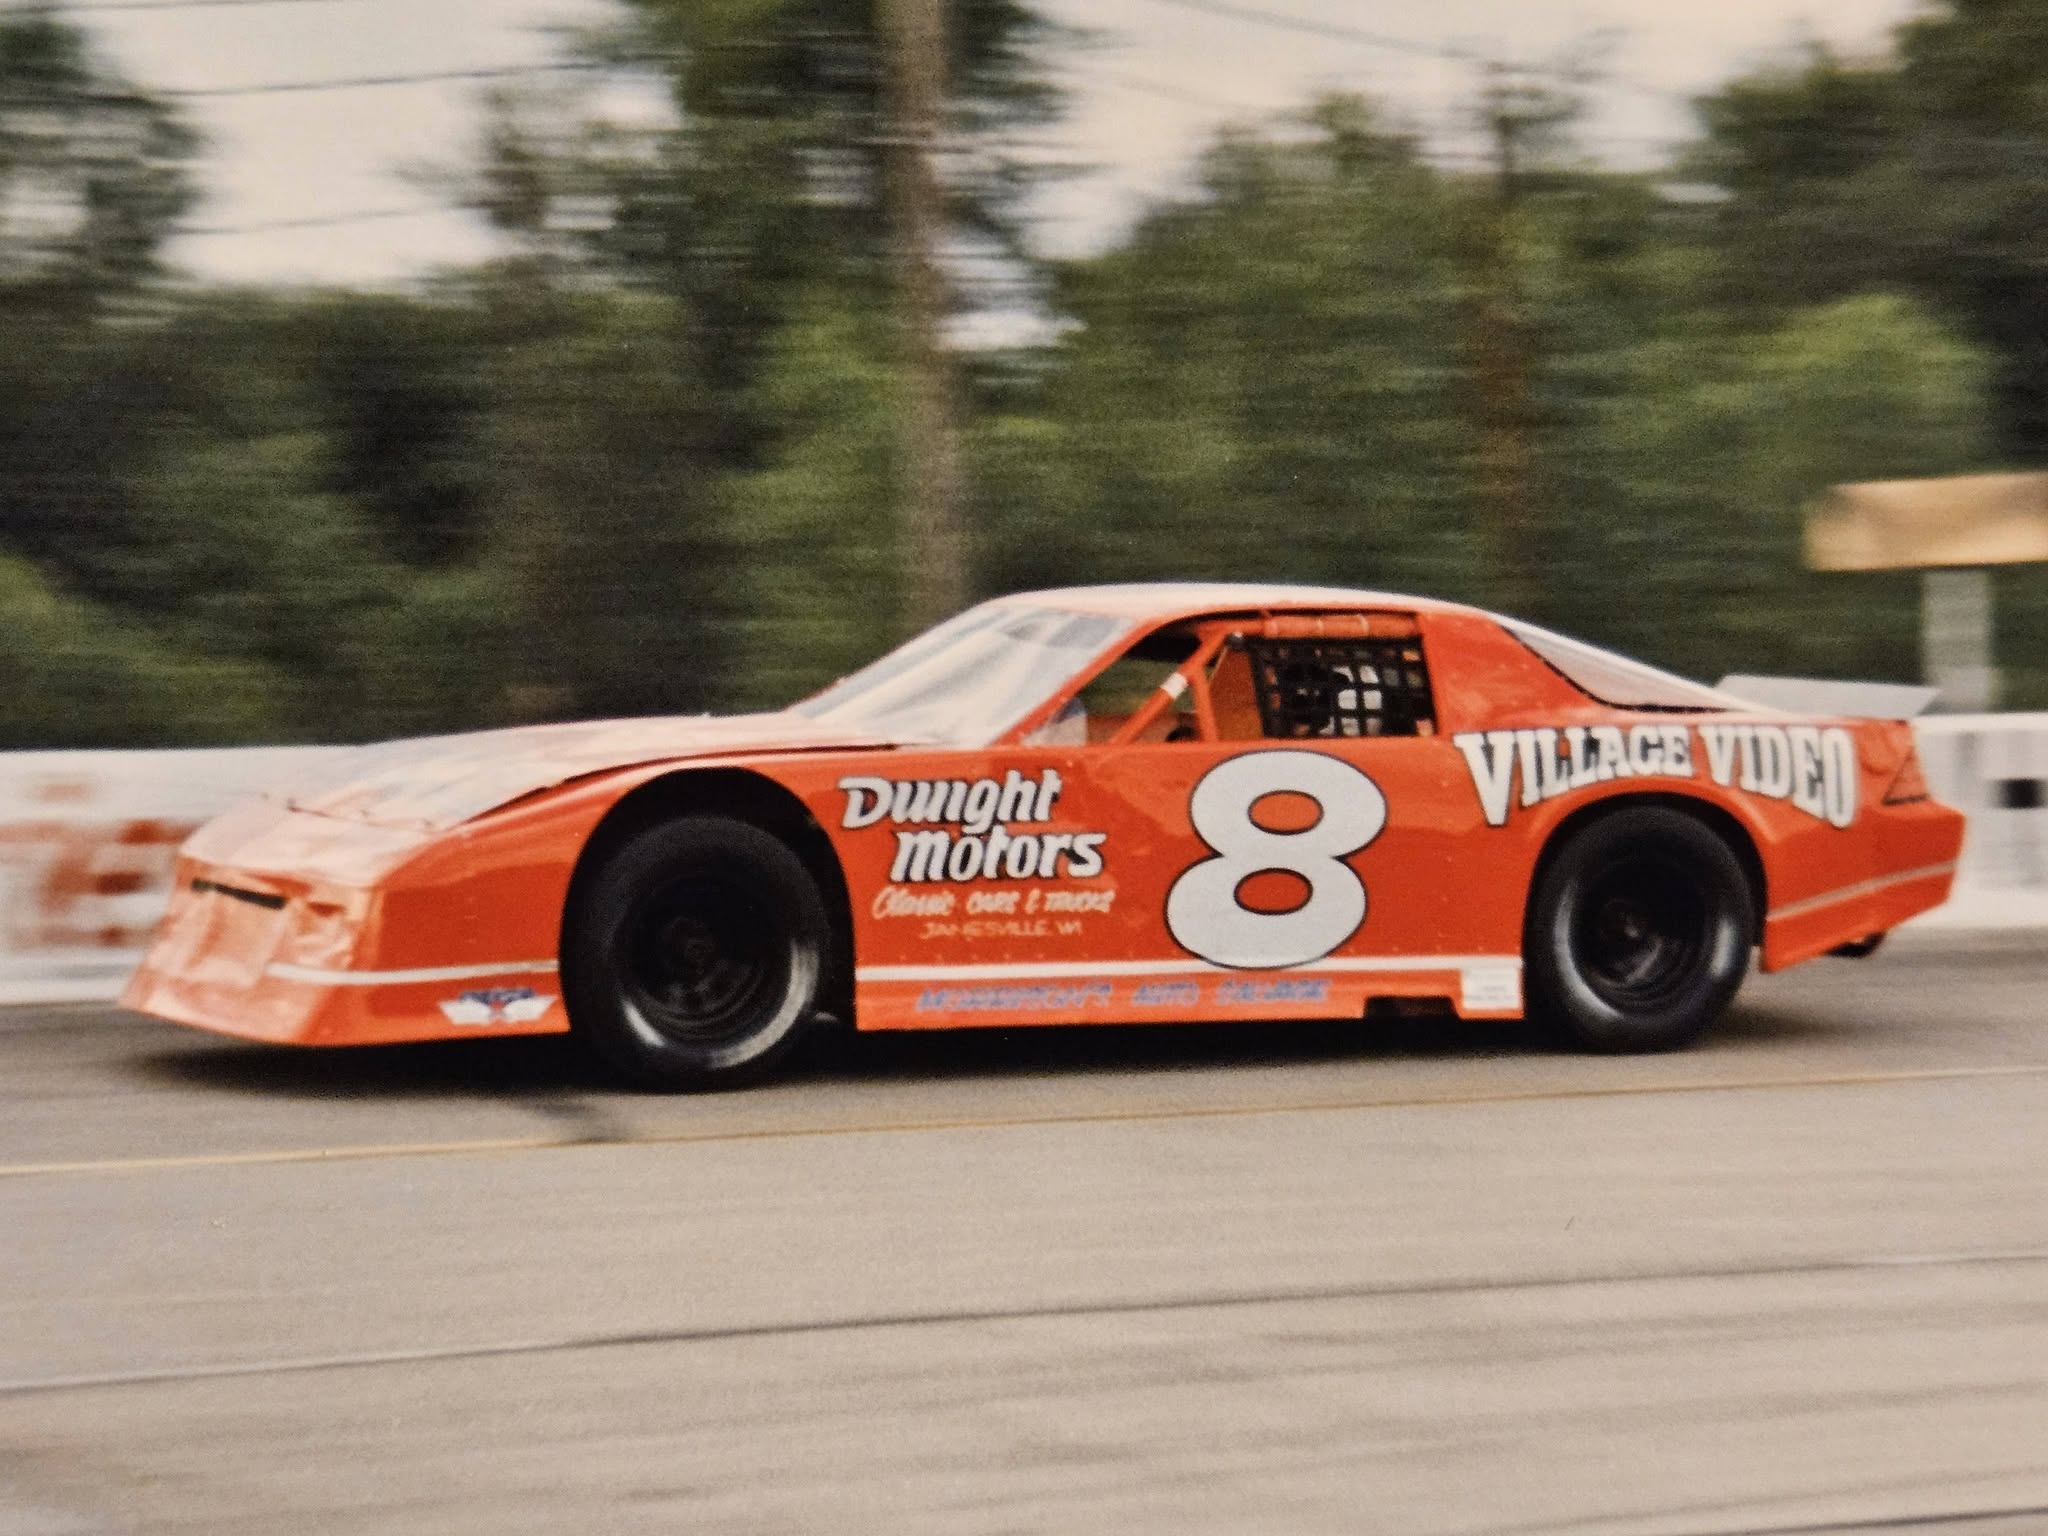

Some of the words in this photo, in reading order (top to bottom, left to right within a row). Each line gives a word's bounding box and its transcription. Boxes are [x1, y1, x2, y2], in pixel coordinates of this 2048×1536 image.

[838, 768, 1063, 836] Dwight
[1453, 724, 1694, 827] VILLAGE
[1698, 723, 1858, 828] VIDEO
[1163, 747, 1388, 970] 8
